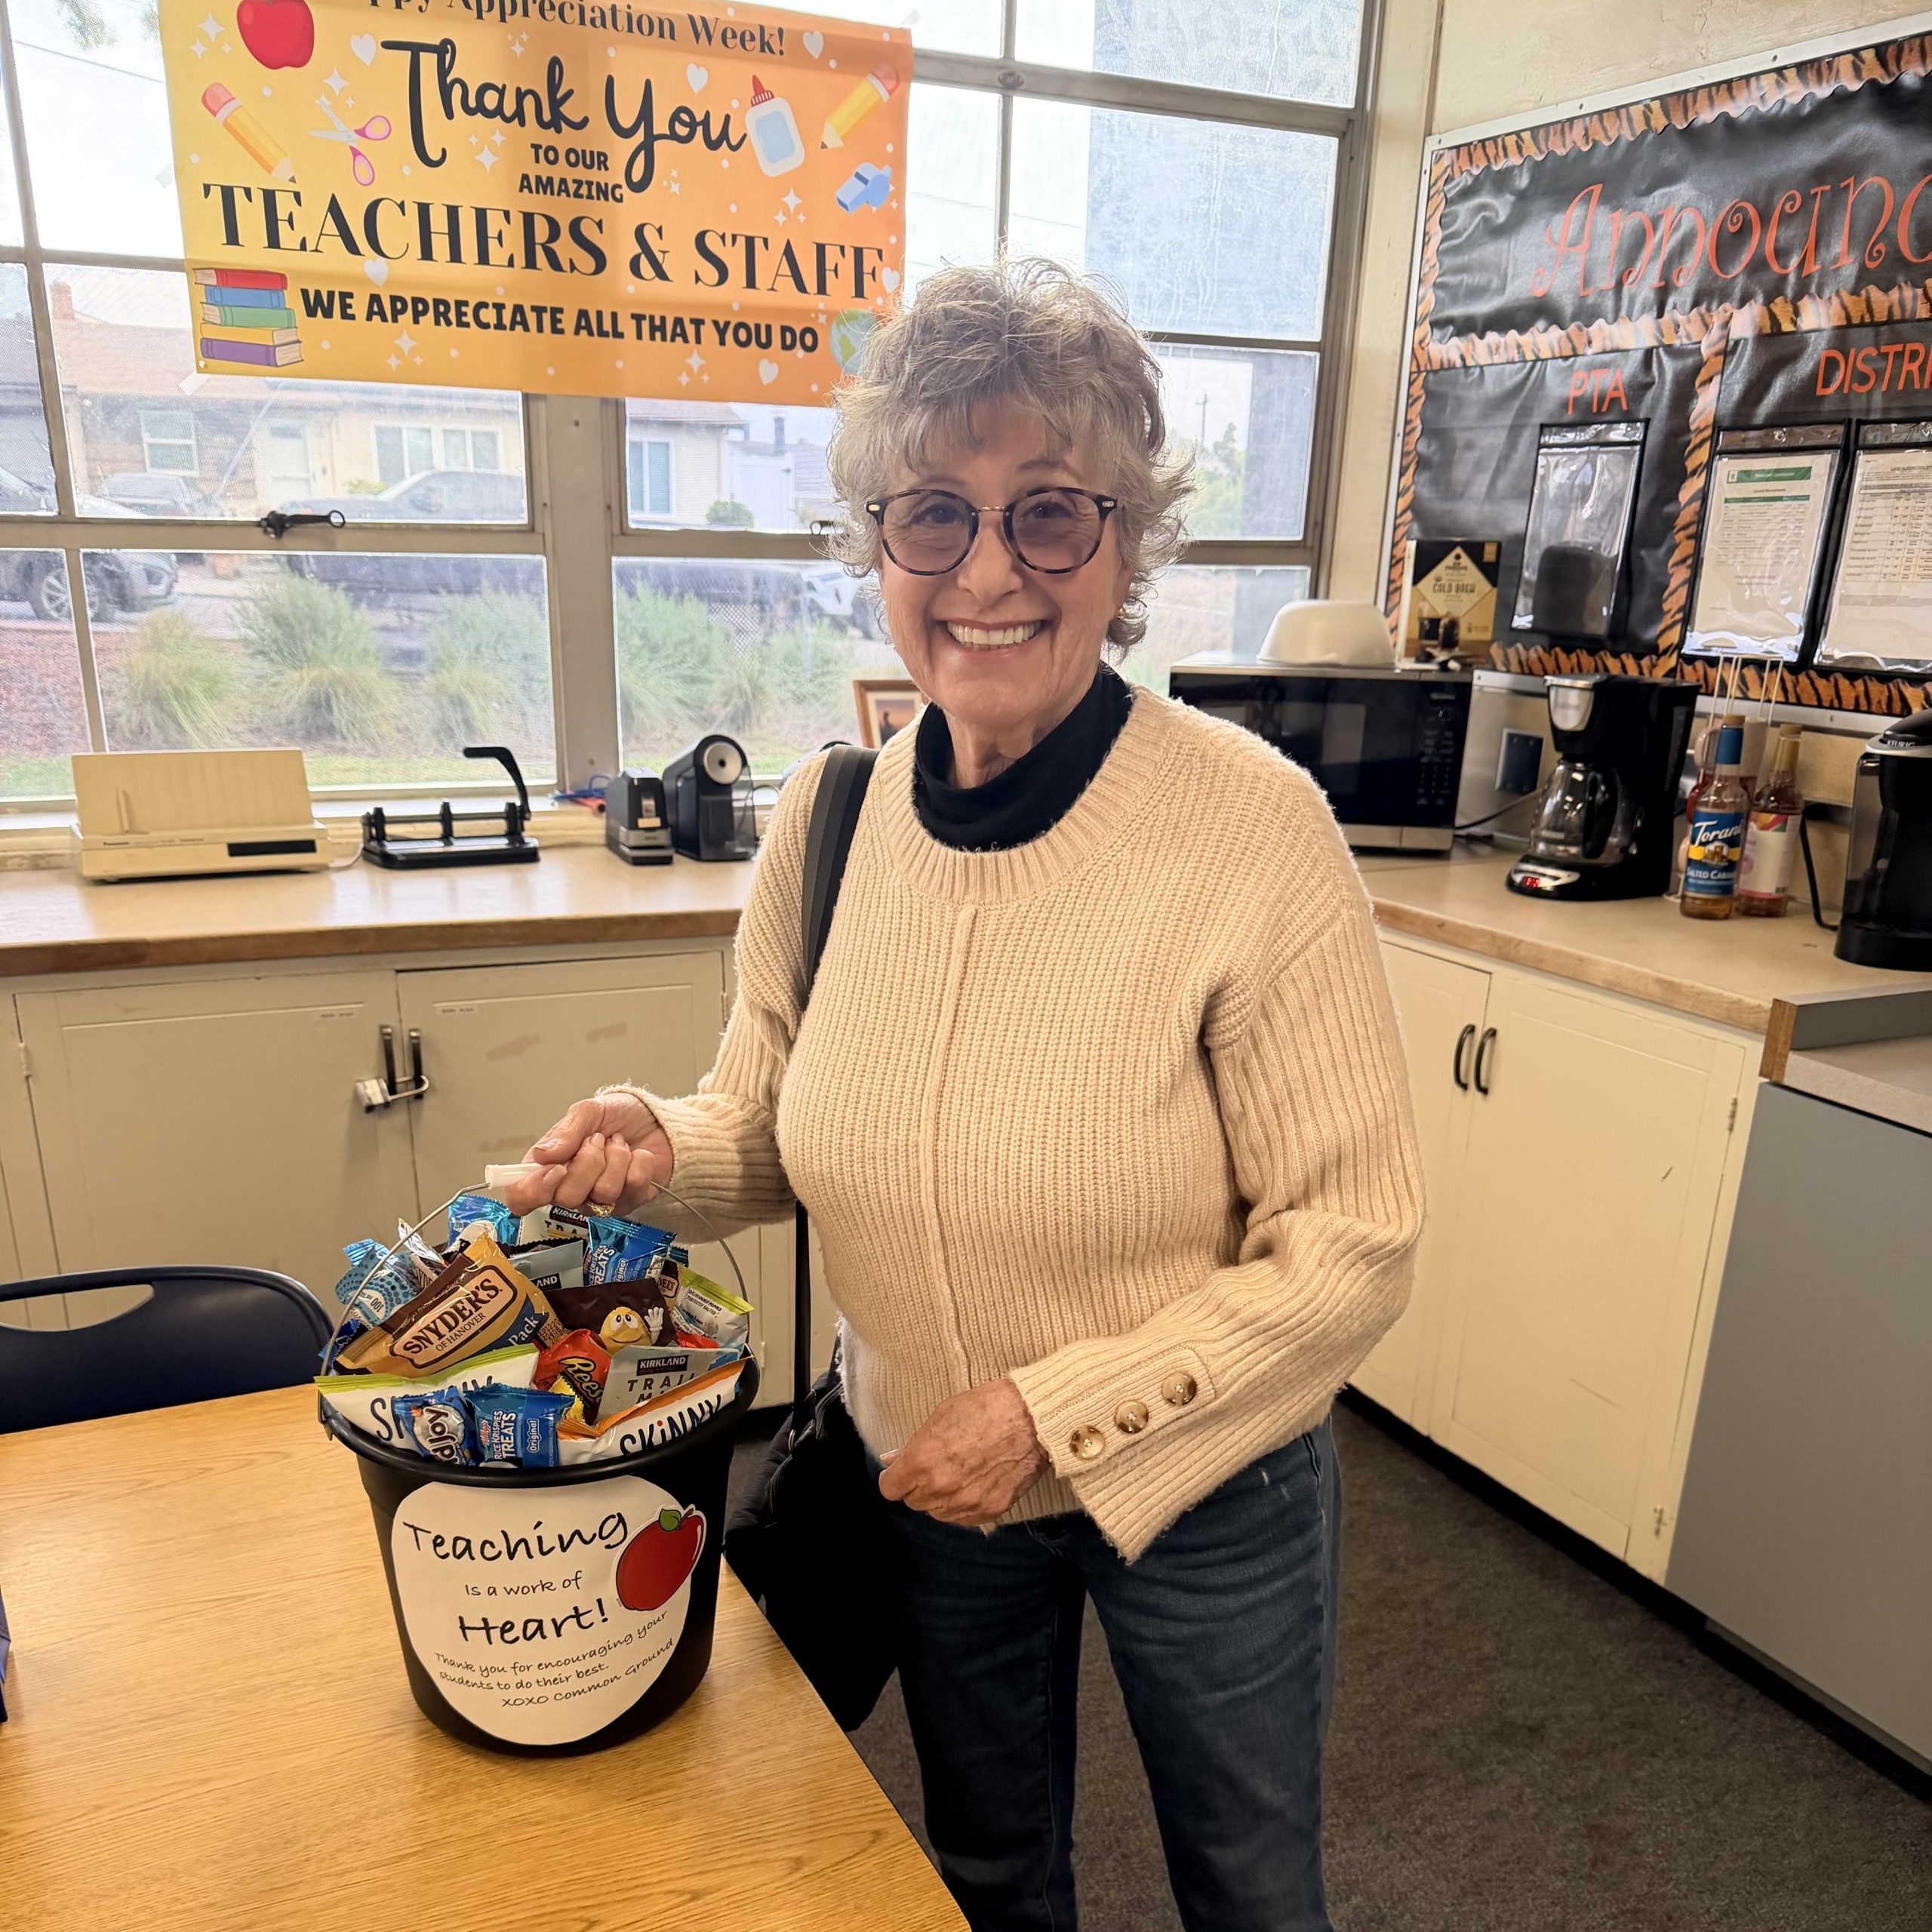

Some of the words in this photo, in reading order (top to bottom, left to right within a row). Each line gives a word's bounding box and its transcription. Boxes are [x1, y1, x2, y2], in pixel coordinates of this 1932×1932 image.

[686, 13, 785, 56] Week!
[381, 38, 590, 168] Thank
[605, 74, 746, 194] You
[531, 143, 560, 165] TO
[565, 147, 609, 171] OUR
[518, 173, 624, 203] AMAZING
[203, 183, 607, 277] TEACHERS
[629, 222, 673, 282] &
[694, 229, 883, 300] STAFF
[300, 288, 355, 321] WE
[366, 293, 565, 336] APPRECIATE
[574, 308, 624, 340] ALL
[630, 312, 705, 346] THAT
[712, 318, 773, 351] YOU
[780, 325, 819, 353] DO
[1567, 368, 1628, 415] PTA
[1432, 583, 1452, 594] COLD
[552, 1208, 589, 1223] KIRKLAN
[402, 1278, 500, 1355] SNYDER'S
[435, 1340, 450, 1352] OF
[448, 1312, 487, 1346] HANOVER
[508, 1315, 539, 1346] Pack
[640, 1356, 686, 1369] KIRKLAND
[492, 1410, 503, 1443] KRISPIES
[500, 1412, 517, 1458] TREATS
[529, 1420, 540, 1452] Original
[494, 1442, 503, 1460] RICE
[402, 1512, 628, 1561] Teaching
[488, 1586, 498, 1596] a
[503, 1580, 557, 1595] work
[562, 1571, 583, 1590] of
[458, 1598, 608, 1645] Heart!
[435, 1652, 475, 1672] Thank
[479, 1665, 507, 1678] you
[510, 1661, 534, 1675] for
[537, 1633, 633, 1670] encouraging
[637, 1611, 667, 1639] your
[625, 1637, 673, 1676] Ground
[439, 1672, 494, 1690] students
[497, 1681, 511, 1690] to
[515, 1679, 533, 1689] do
[536, 1673, 572, 1687] their
[576, 1663, 609, 1679] best.
